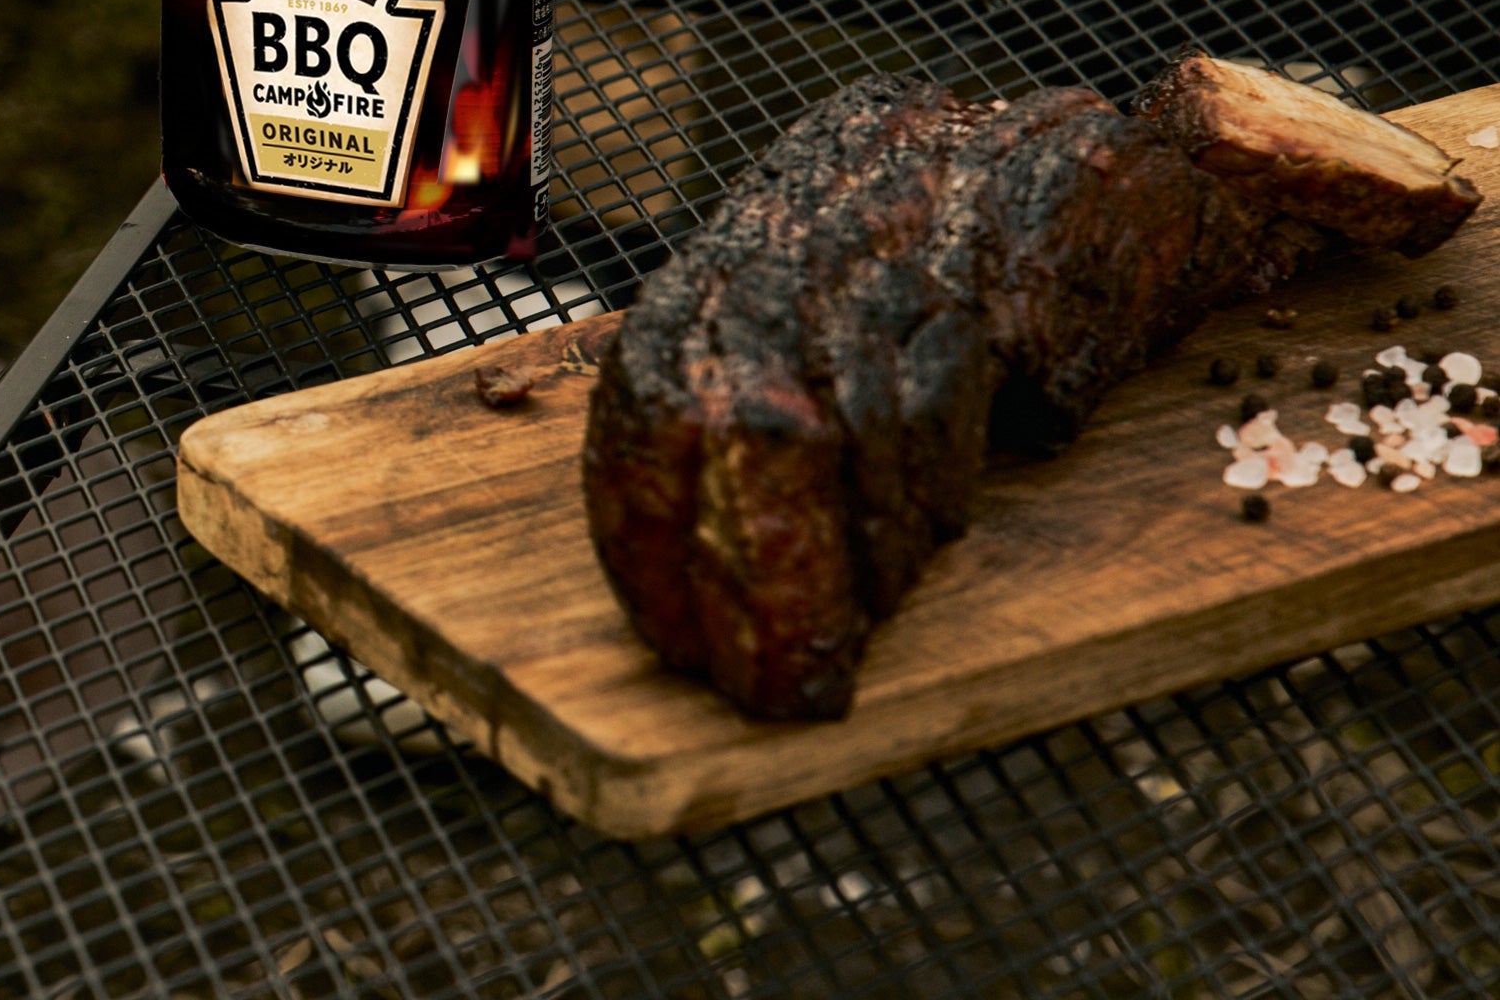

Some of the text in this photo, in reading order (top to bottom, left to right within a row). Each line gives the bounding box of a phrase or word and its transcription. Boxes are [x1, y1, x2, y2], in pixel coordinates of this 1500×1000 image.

[319, 1, 348, 14] 1869
[252, 11, 388, 95] BBQ
[262, 122, 375, 154] ORIGINAL
[283, 152, 353, 174] オリジナル
